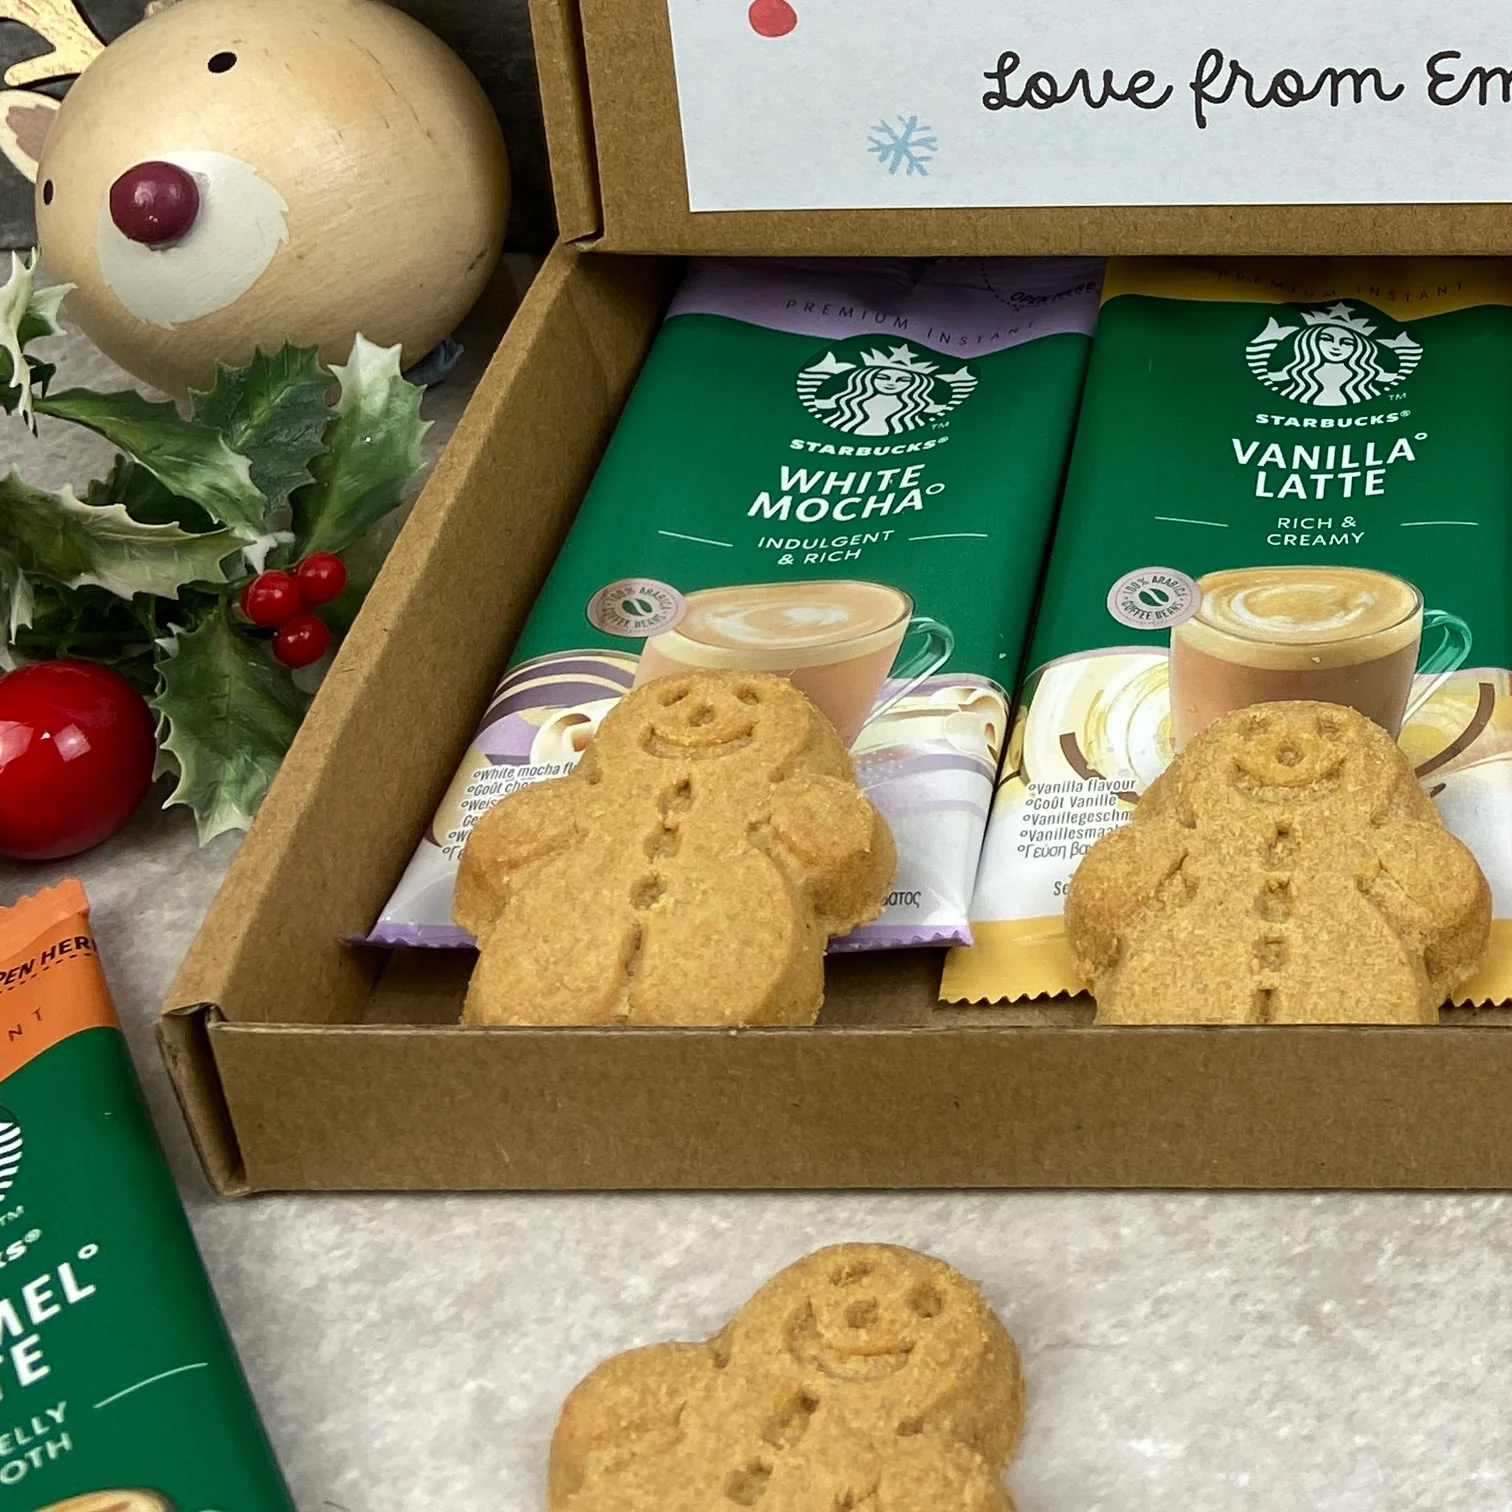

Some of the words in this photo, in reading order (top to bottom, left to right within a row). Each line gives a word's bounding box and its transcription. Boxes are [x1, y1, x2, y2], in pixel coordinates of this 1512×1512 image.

[983, 50, 1175, 112] Love
[1192, 48, 1405, 129] from
[1217, 270, 1337, 299] PREMIUM
[1356, 280, 1464, 303] INSTANT
[785, 299, 910, 330] PREMIUM
[926, 320, 1037, 346] INSTANT
[779, 463, 927, 495] WHITE
[1254, 468, 1386, 501] LATTE
[1277, 516, 1333, 531] RICH
[1342, 515, 1358, 529] &
[757, 530, 896, 551] INDULGENT
[1265, 530, 1367, 548] CREAMY
[777, 554, 794, 566] &
[802, 548, 863, 566] RICH
[517, 764, 562, 779] mocha
[1087, 778, 1137, 793] flavour
[1069, 793, 1118, 809] Vanille
[40, 935, 98, 967] HER
